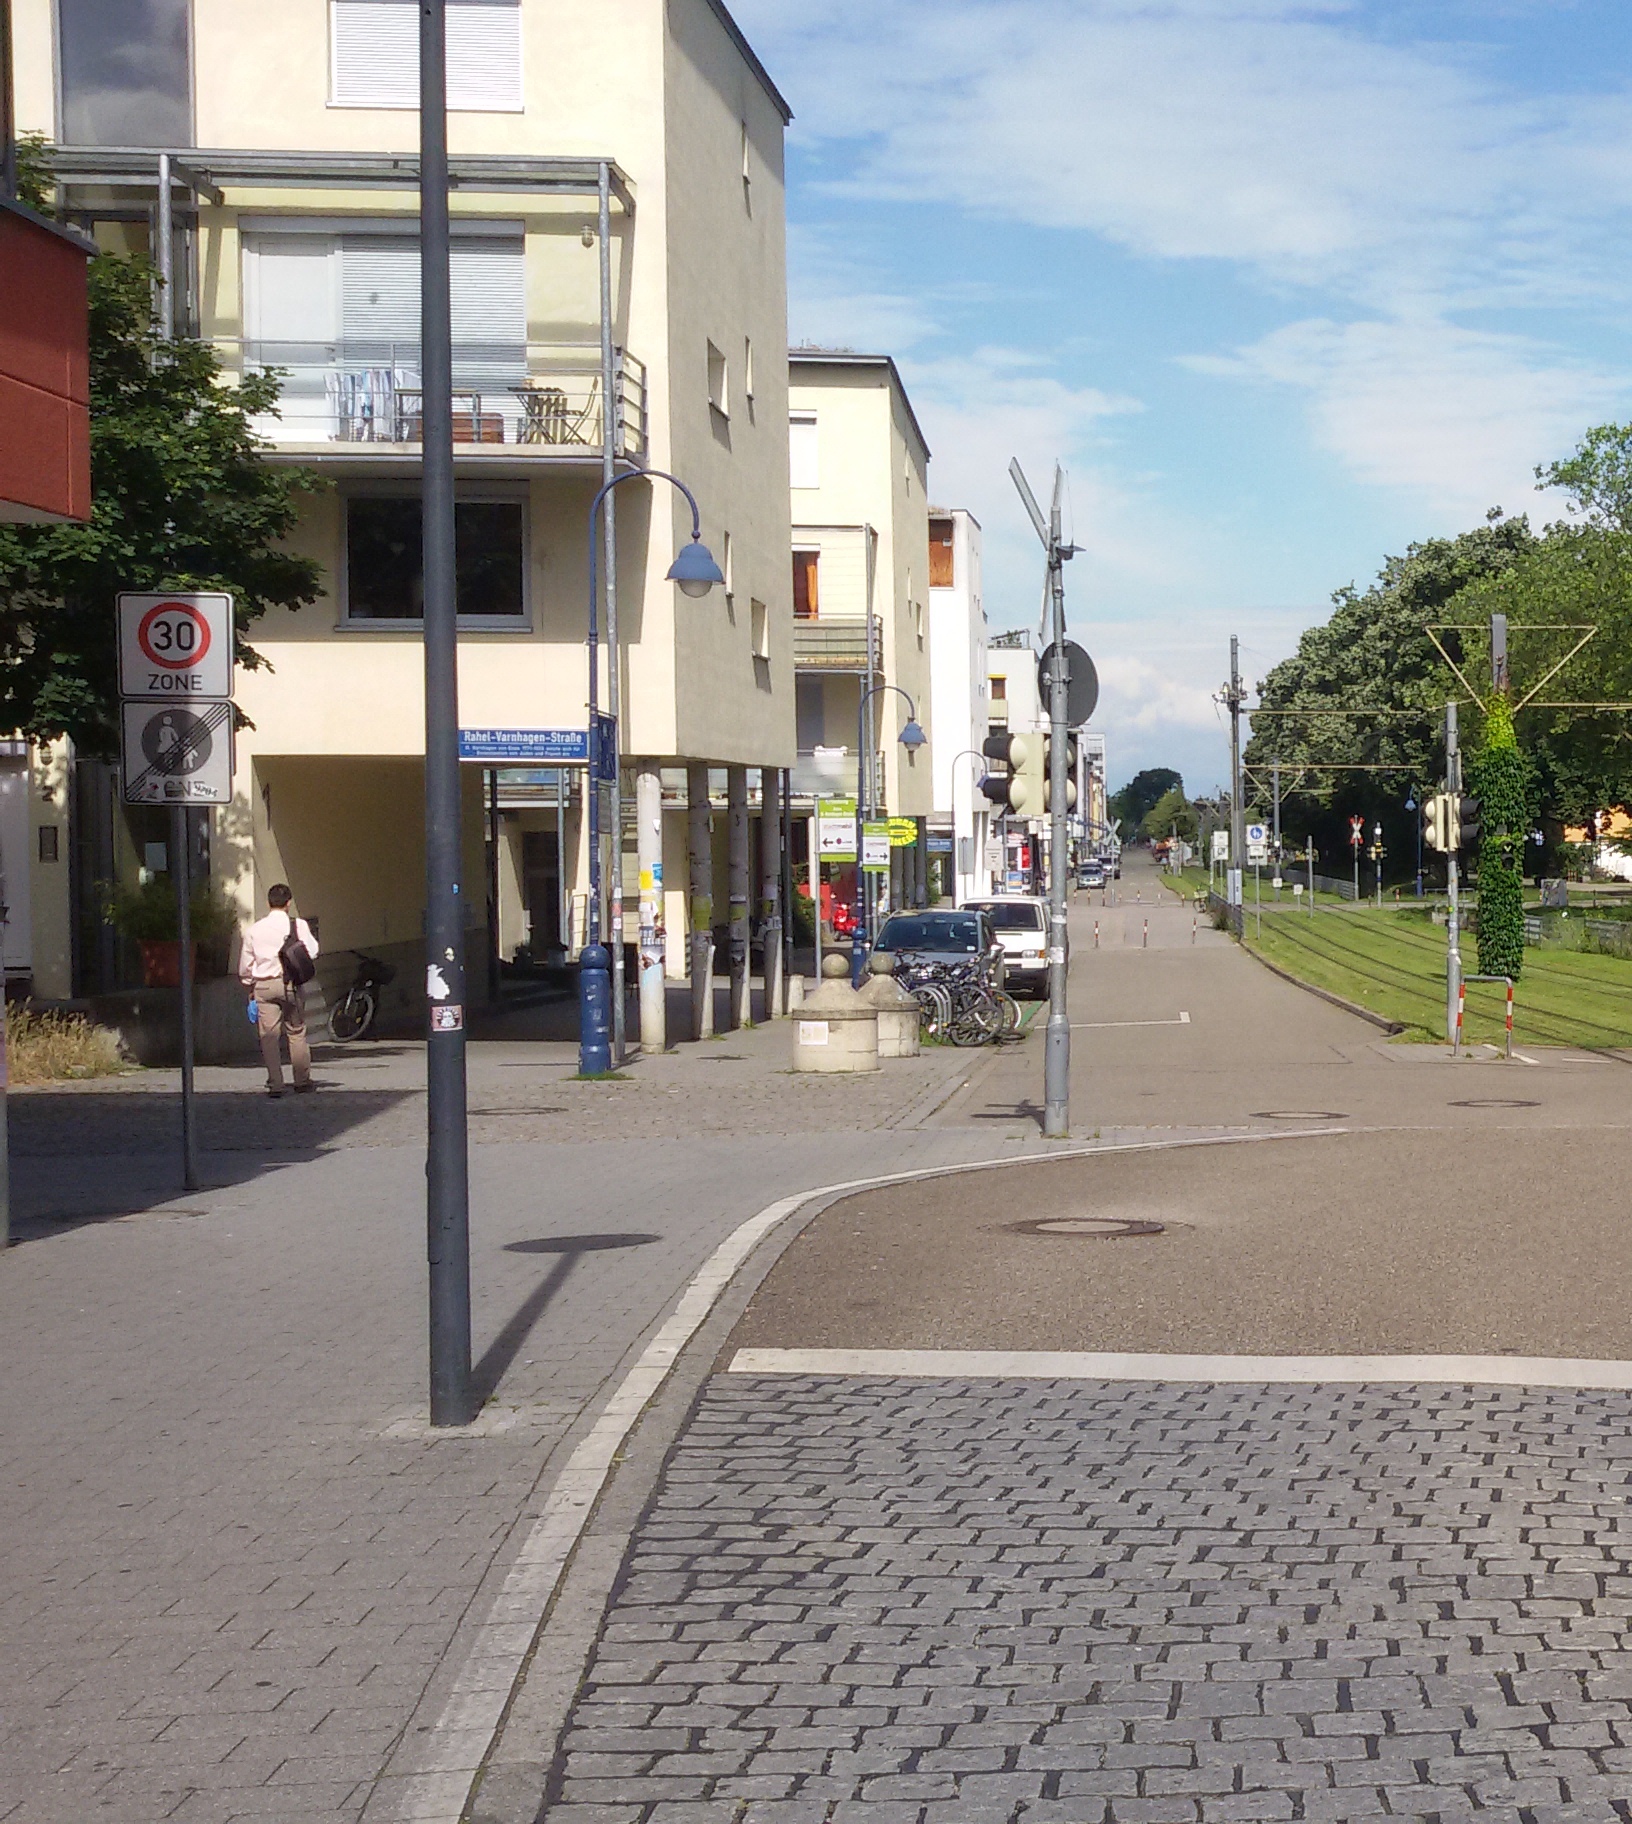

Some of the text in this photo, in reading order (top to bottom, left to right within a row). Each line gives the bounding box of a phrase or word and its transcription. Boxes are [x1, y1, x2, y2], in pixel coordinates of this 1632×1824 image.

[153, 620, 195, 651] 30
[147, 673, 203, 691] ZONE
[464, 731, 582, 745] Rahel-Varnhagen-Straße
